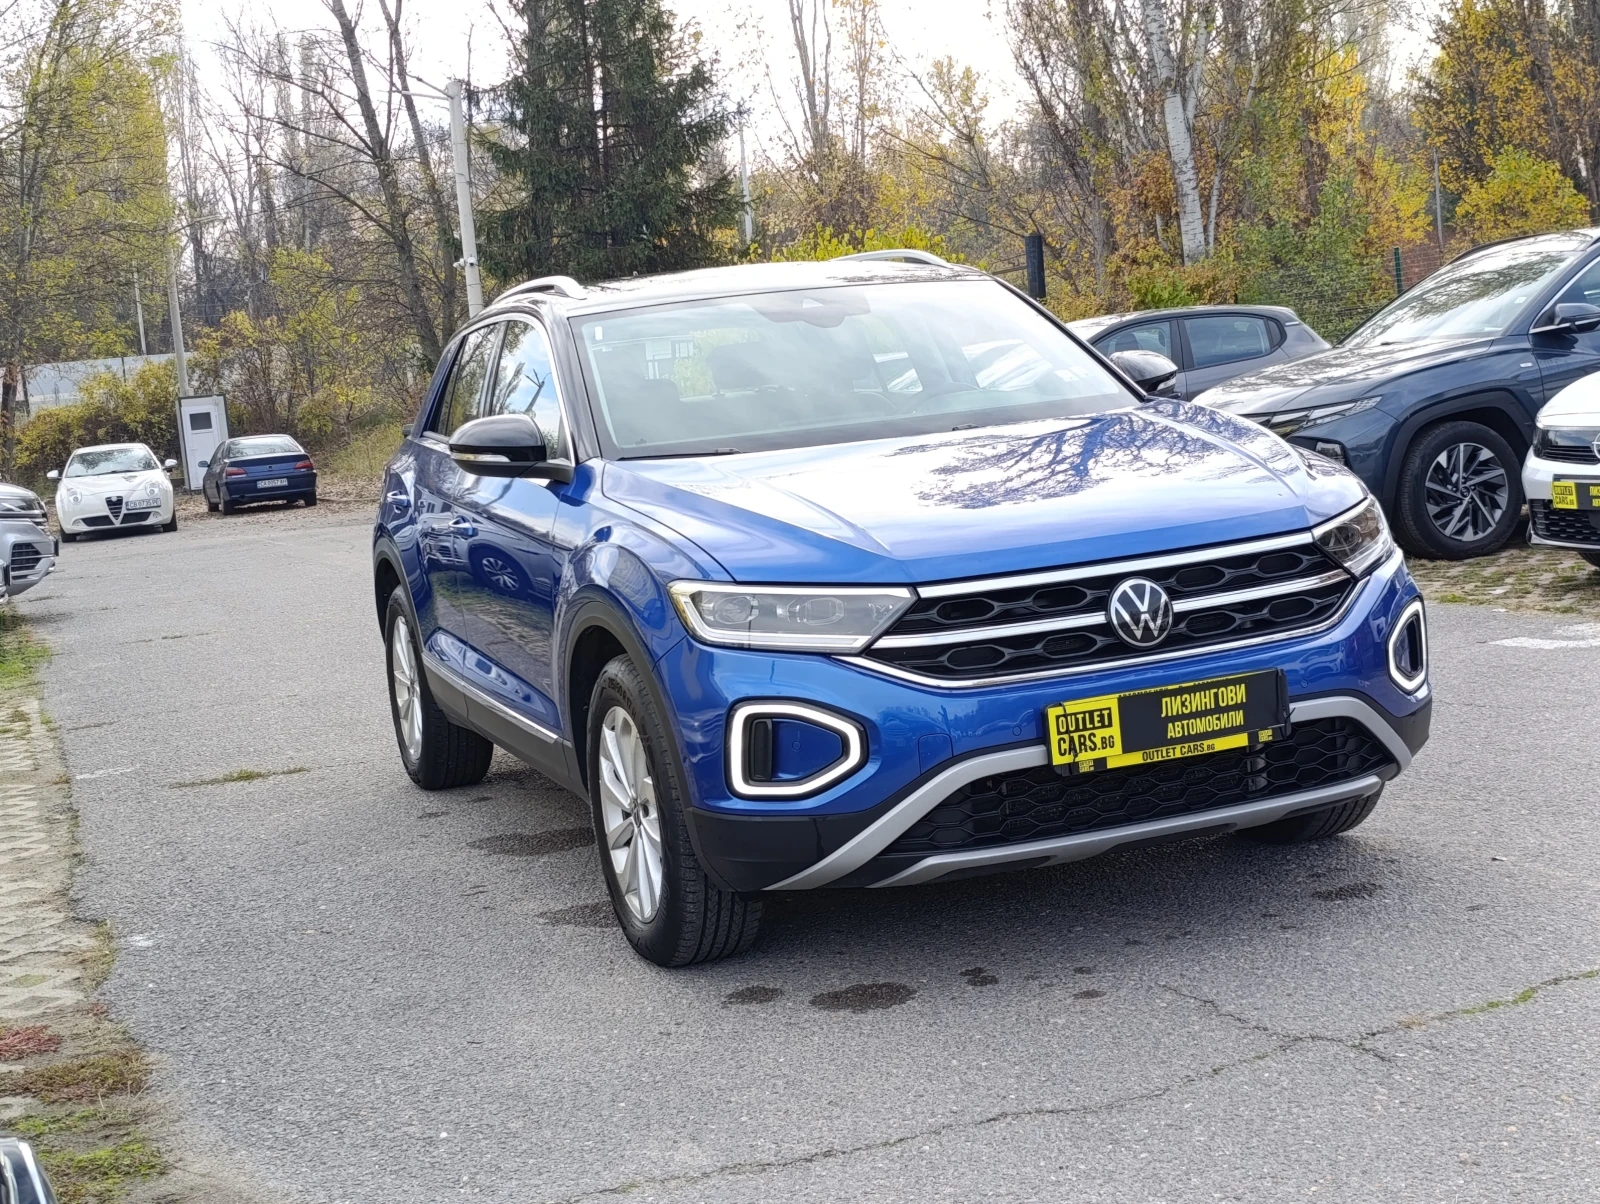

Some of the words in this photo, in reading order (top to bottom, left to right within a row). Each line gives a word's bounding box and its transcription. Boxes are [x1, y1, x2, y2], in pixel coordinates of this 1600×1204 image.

[1161, 683, 1247, 718] ЛИЗИНГОВИ
[1058, 709, 1110, 733] OUTLET
[1167, 709, 1244, 739] АВТОМОБИЛИ
[1057, 731, 1115, 757] CARS.BG
[1141, 746, 1177, 762] OUTLET
[1180, 742, 1216, 756] CARS.BG
